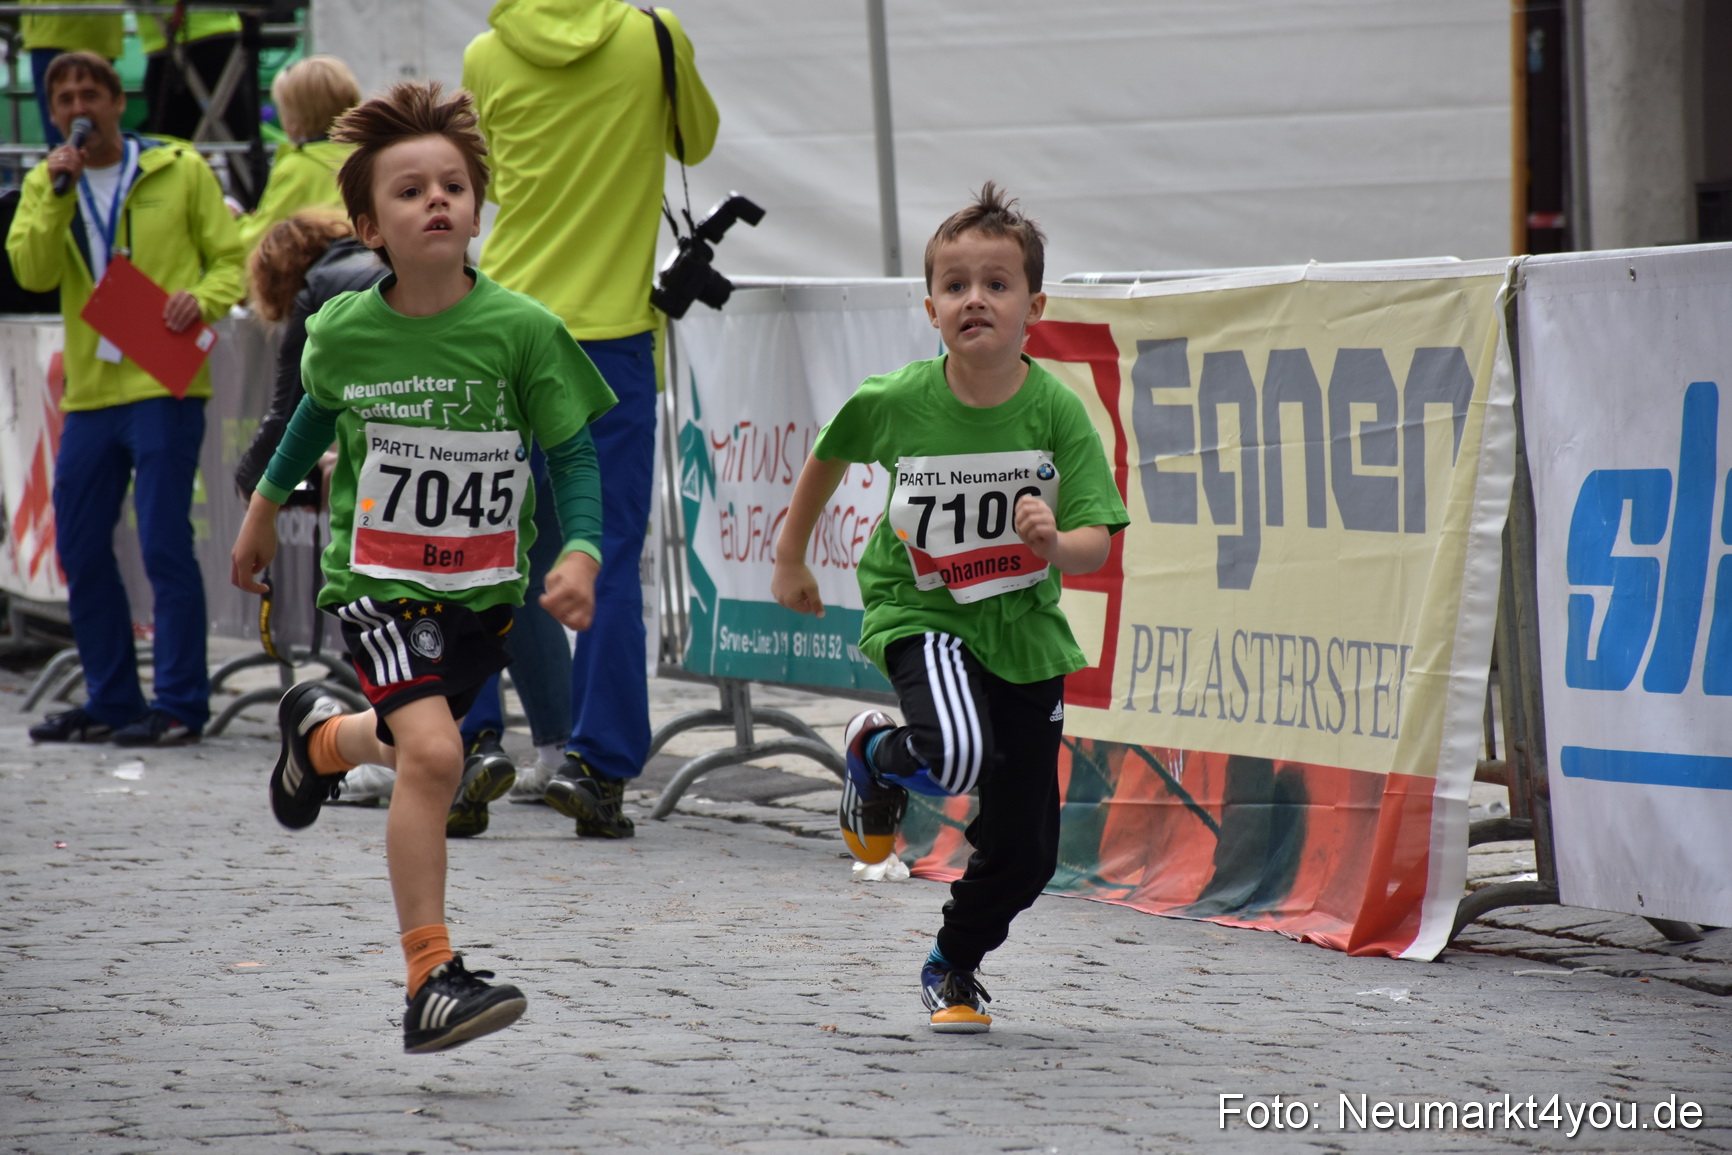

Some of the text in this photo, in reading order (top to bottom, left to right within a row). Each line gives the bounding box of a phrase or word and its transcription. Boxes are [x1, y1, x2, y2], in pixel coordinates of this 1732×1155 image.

[343, 375, 457, 401] Neumarkter
[372, 437, 510, 462] PARTL Neumarkt
[899, 472, 946, 486] PARTL
[950, 468, 1030, 485] Neumarkt
[379, 463, 515, 528] 7045
[362, 515, 369, 527] 2
[423, 543, 464, 568] Ben
[939, 555, 1021, 584] ohannes
[828, 634, 842, 660] 52
